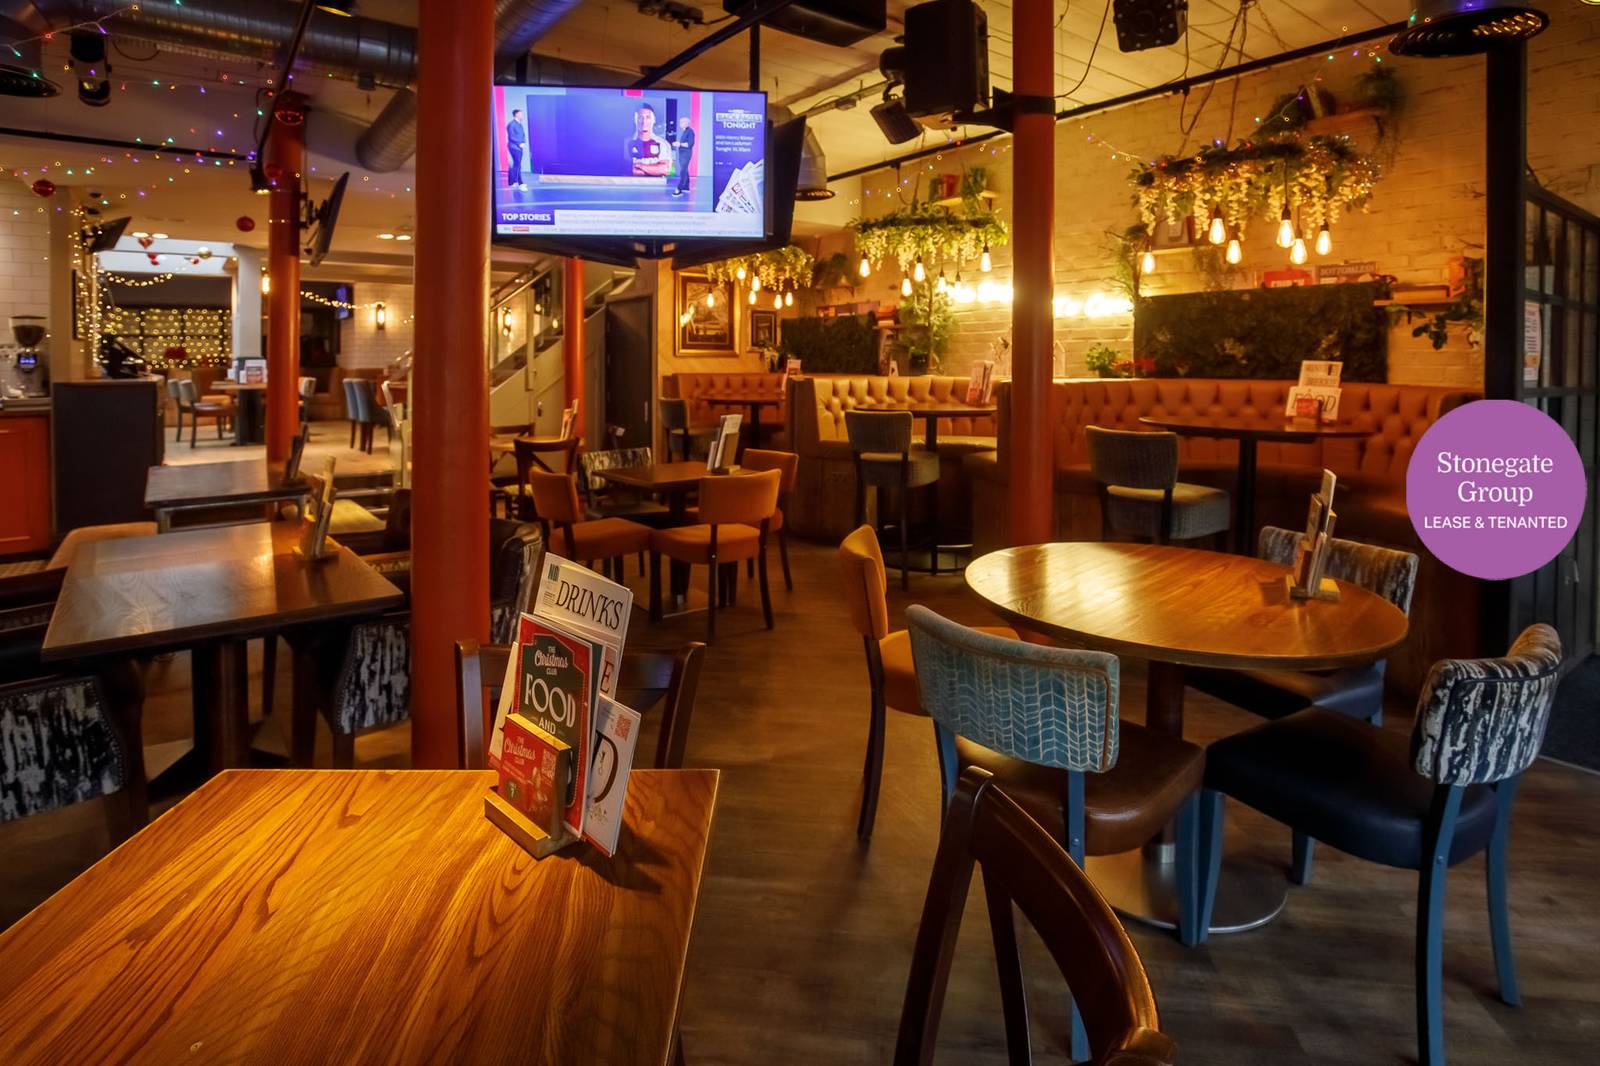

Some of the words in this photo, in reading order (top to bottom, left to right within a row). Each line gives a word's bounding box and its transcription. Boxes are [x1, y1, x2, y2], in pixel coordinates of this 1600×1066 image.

[502, 213, 519, 221] TOP
[519, 213, 551, 222] STORIES
[555, 580, 624, 630] DRINKS
[534, 649, 568, 668] Christmas
[524, 672, 576, 728] FOOD
[538, 717, 556, 735] AND
[504, 737, 536, 760] Christmas
